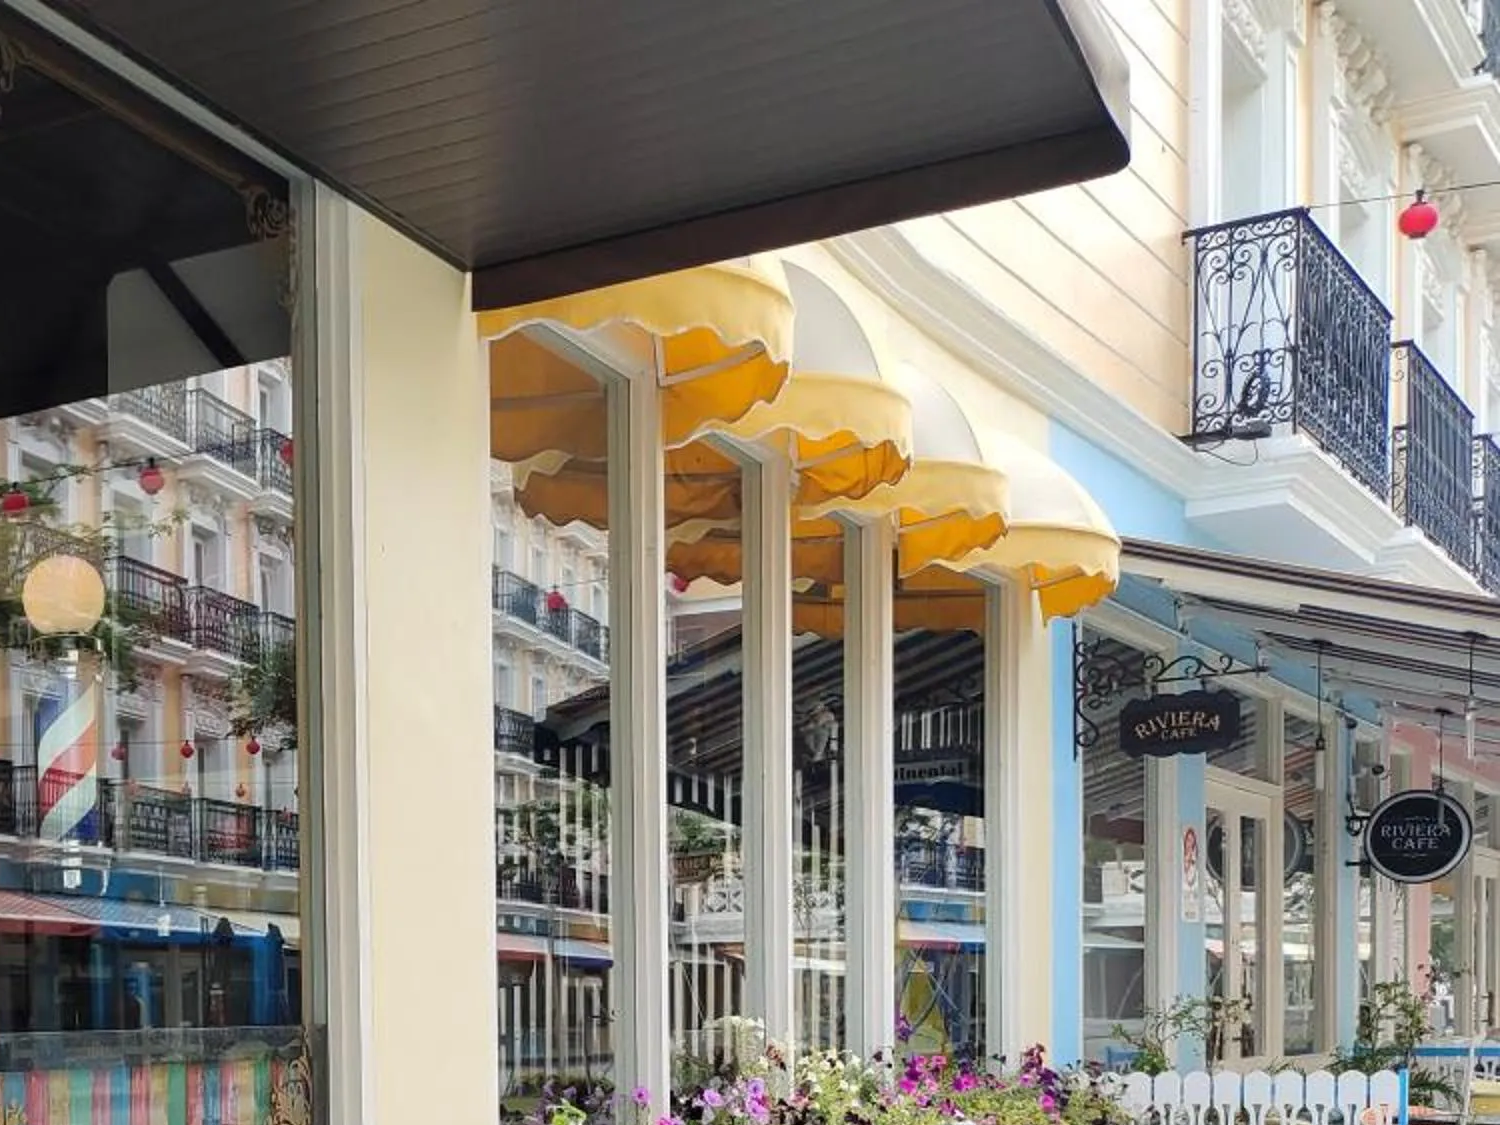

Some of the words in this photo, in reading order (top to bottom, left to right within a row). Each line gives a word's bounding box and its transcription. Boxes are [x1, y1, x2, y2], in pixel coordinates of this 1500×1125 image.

[1134, 711, 1220, 739] RIVIERA
[1381, 823, 1451, 838] RIVIERA
[1391, 838, 1439, 849] CAFE
